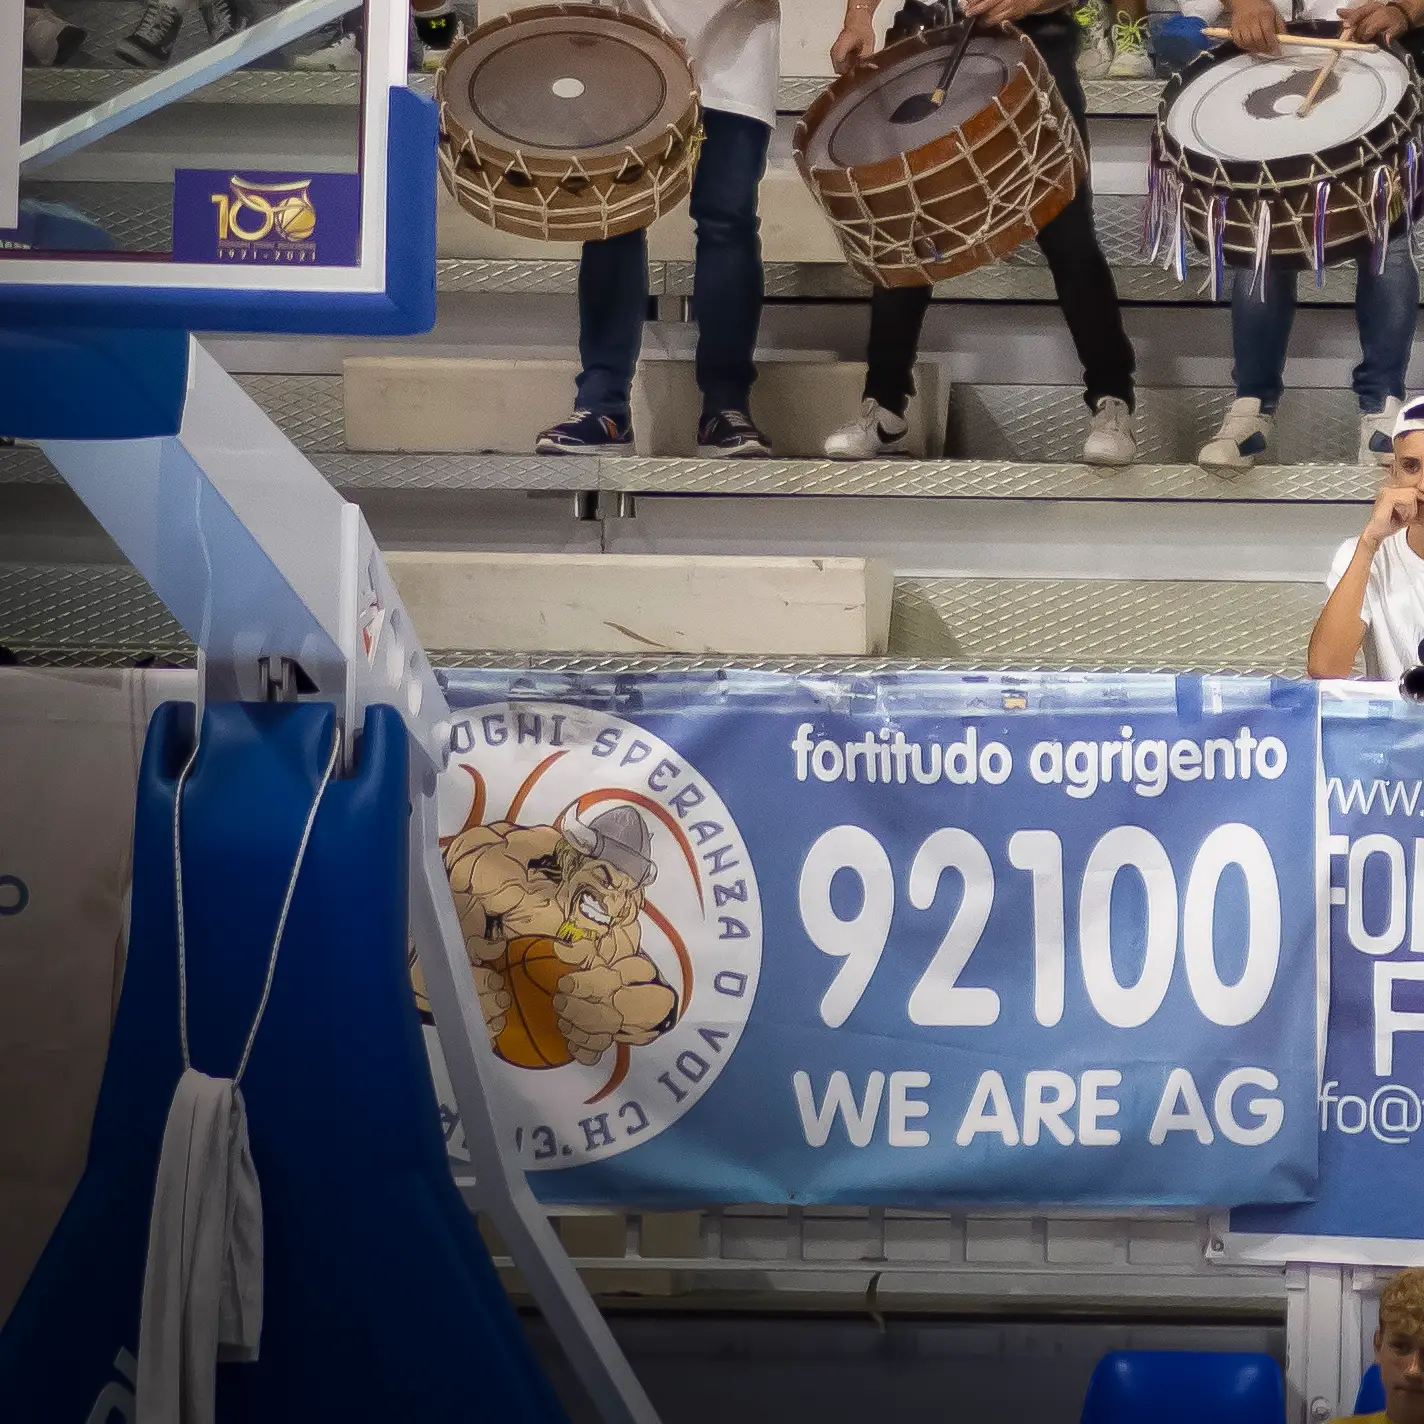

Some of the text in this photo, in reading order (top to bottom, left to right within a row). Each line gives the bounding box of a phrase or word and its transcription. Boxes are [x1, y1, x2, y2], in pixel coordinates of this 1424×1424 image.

[792, 722, 1289, 799] fortitudo agrigento
[592, 727, 751, 940] SPERANZA
[800, 822, 1285, 1029] 92100
[658, 1025, 731, 1104] VOI
[513, 1100, 651, 1161] CH'E
[792, 1068, 1286, 1148] WE ARE AG
